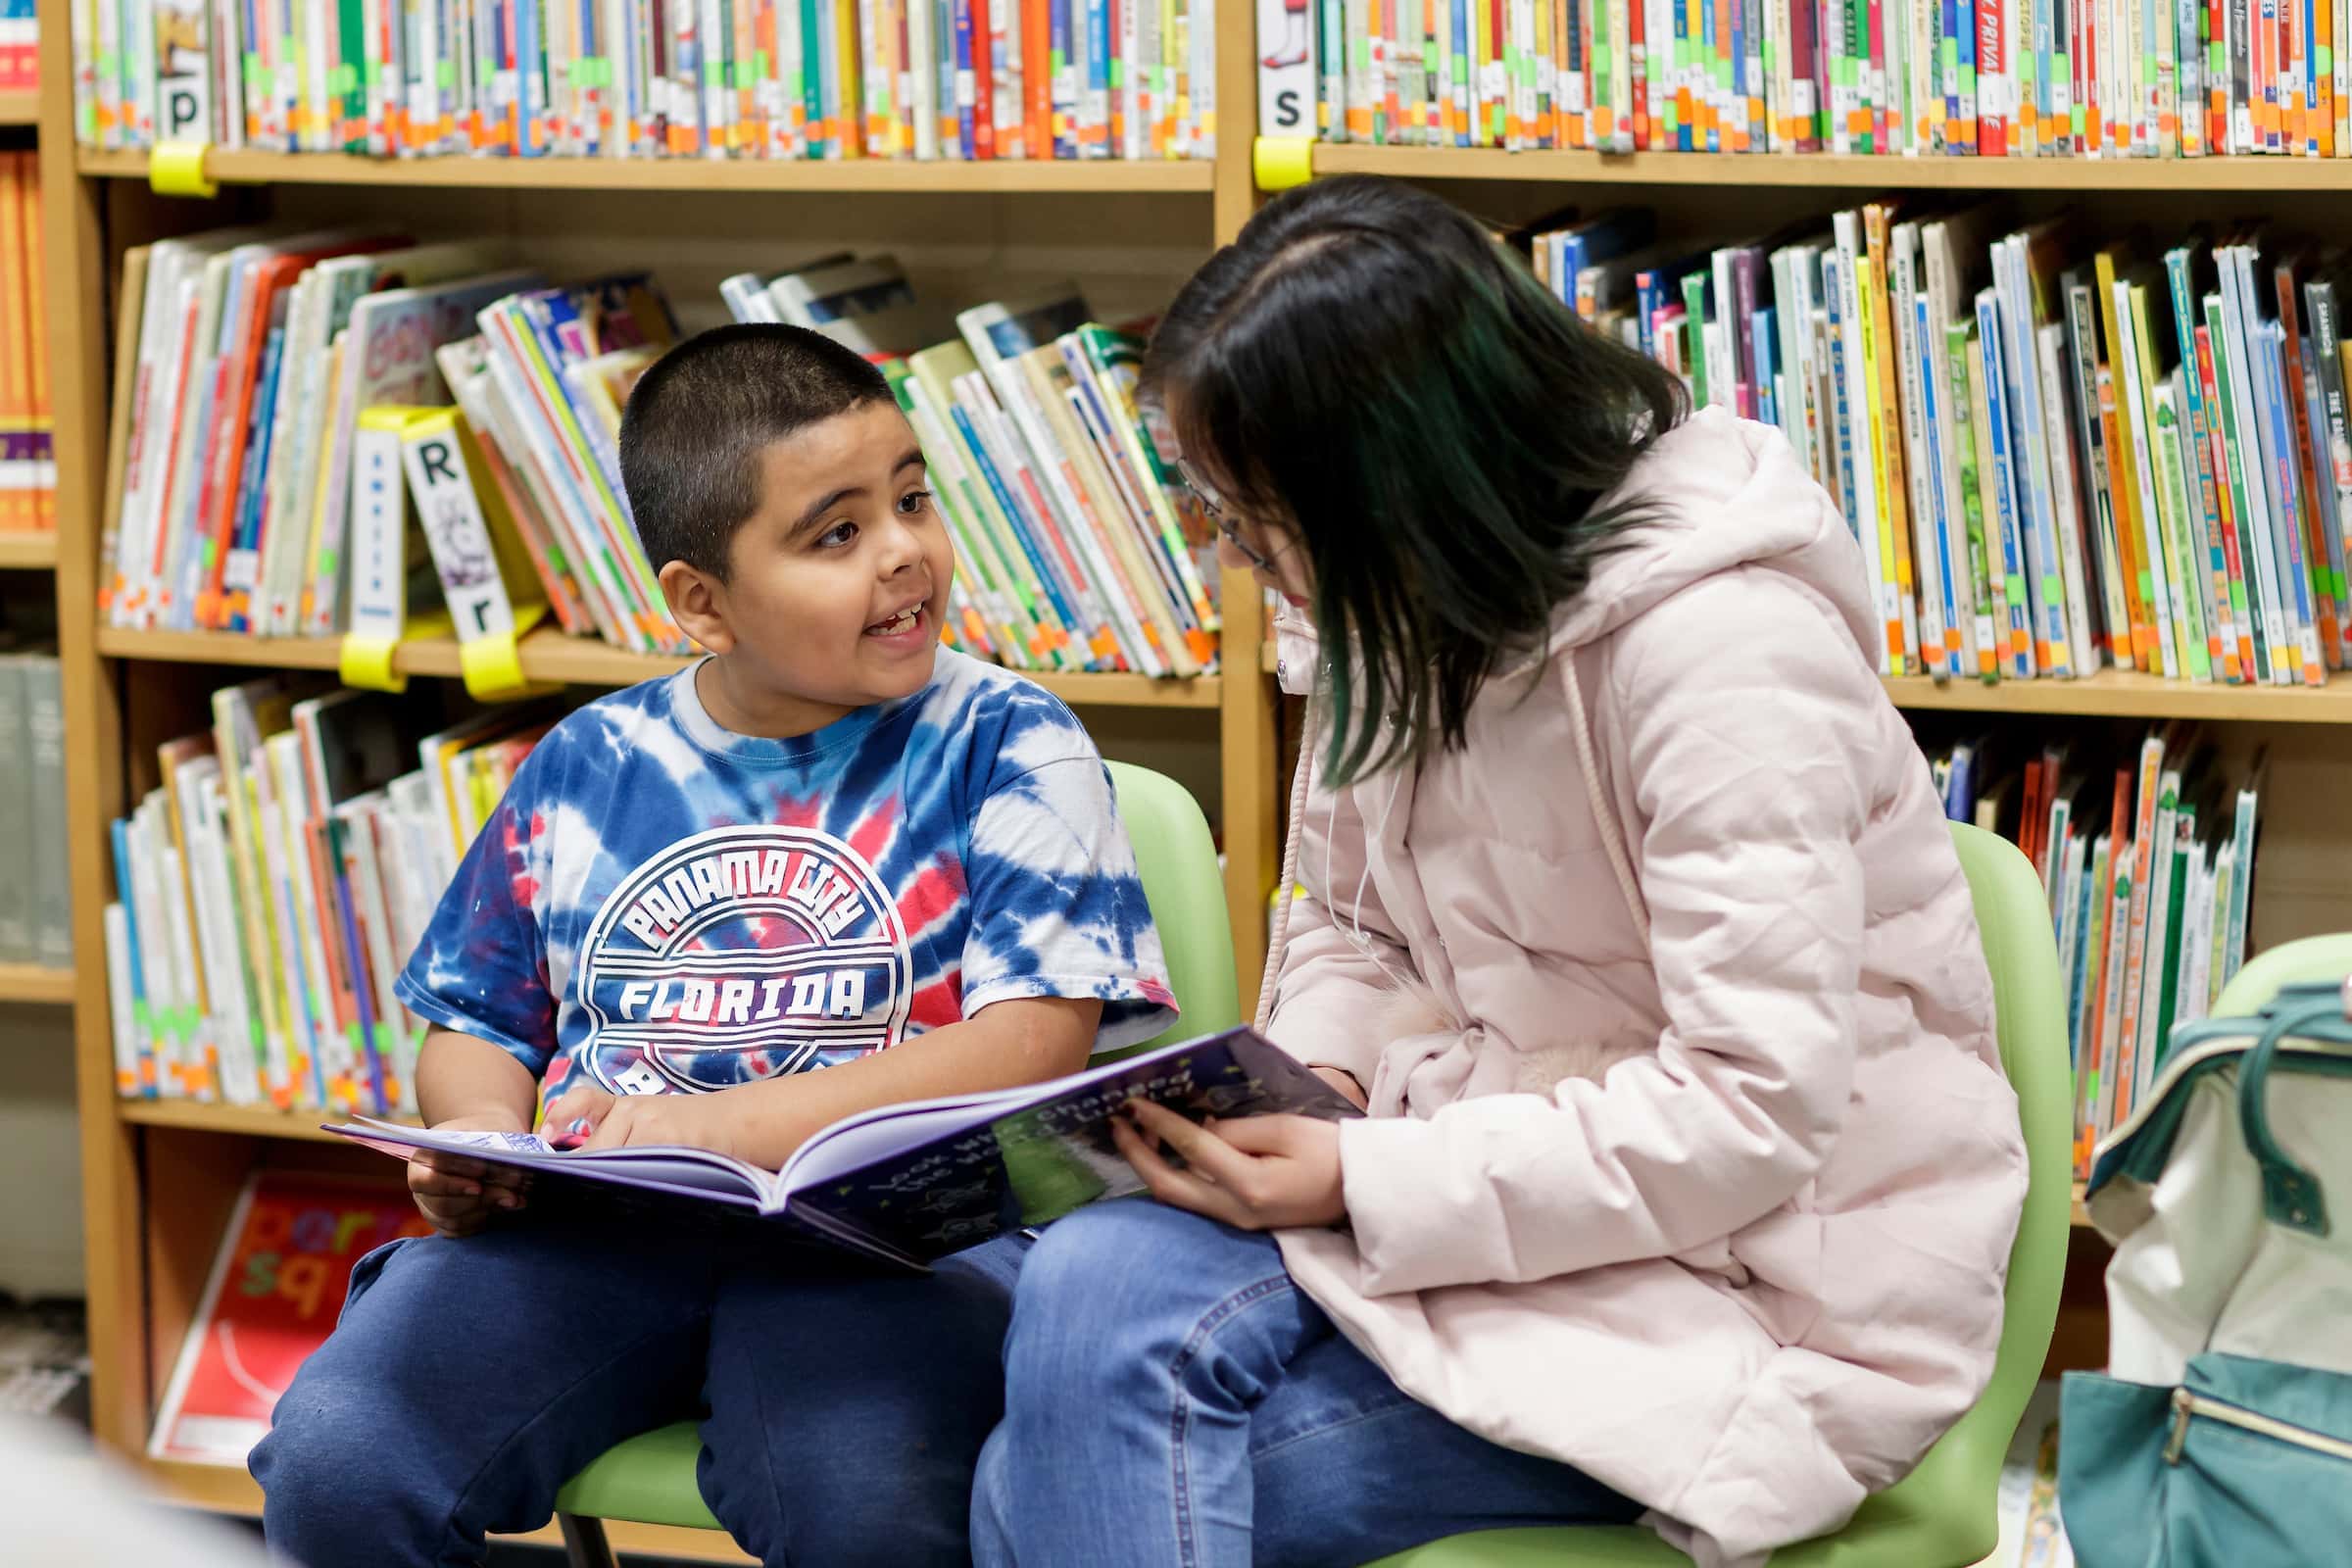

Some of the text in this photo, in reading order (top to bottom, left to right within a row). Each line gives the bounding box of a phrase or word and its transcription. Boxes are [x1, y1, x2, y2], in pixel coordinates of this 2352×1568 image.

[417, 441, 458, 486] R
[622, 849, 866, 952] PANAMA CITY
[618, 969, 866, 1026] FLORIDA
